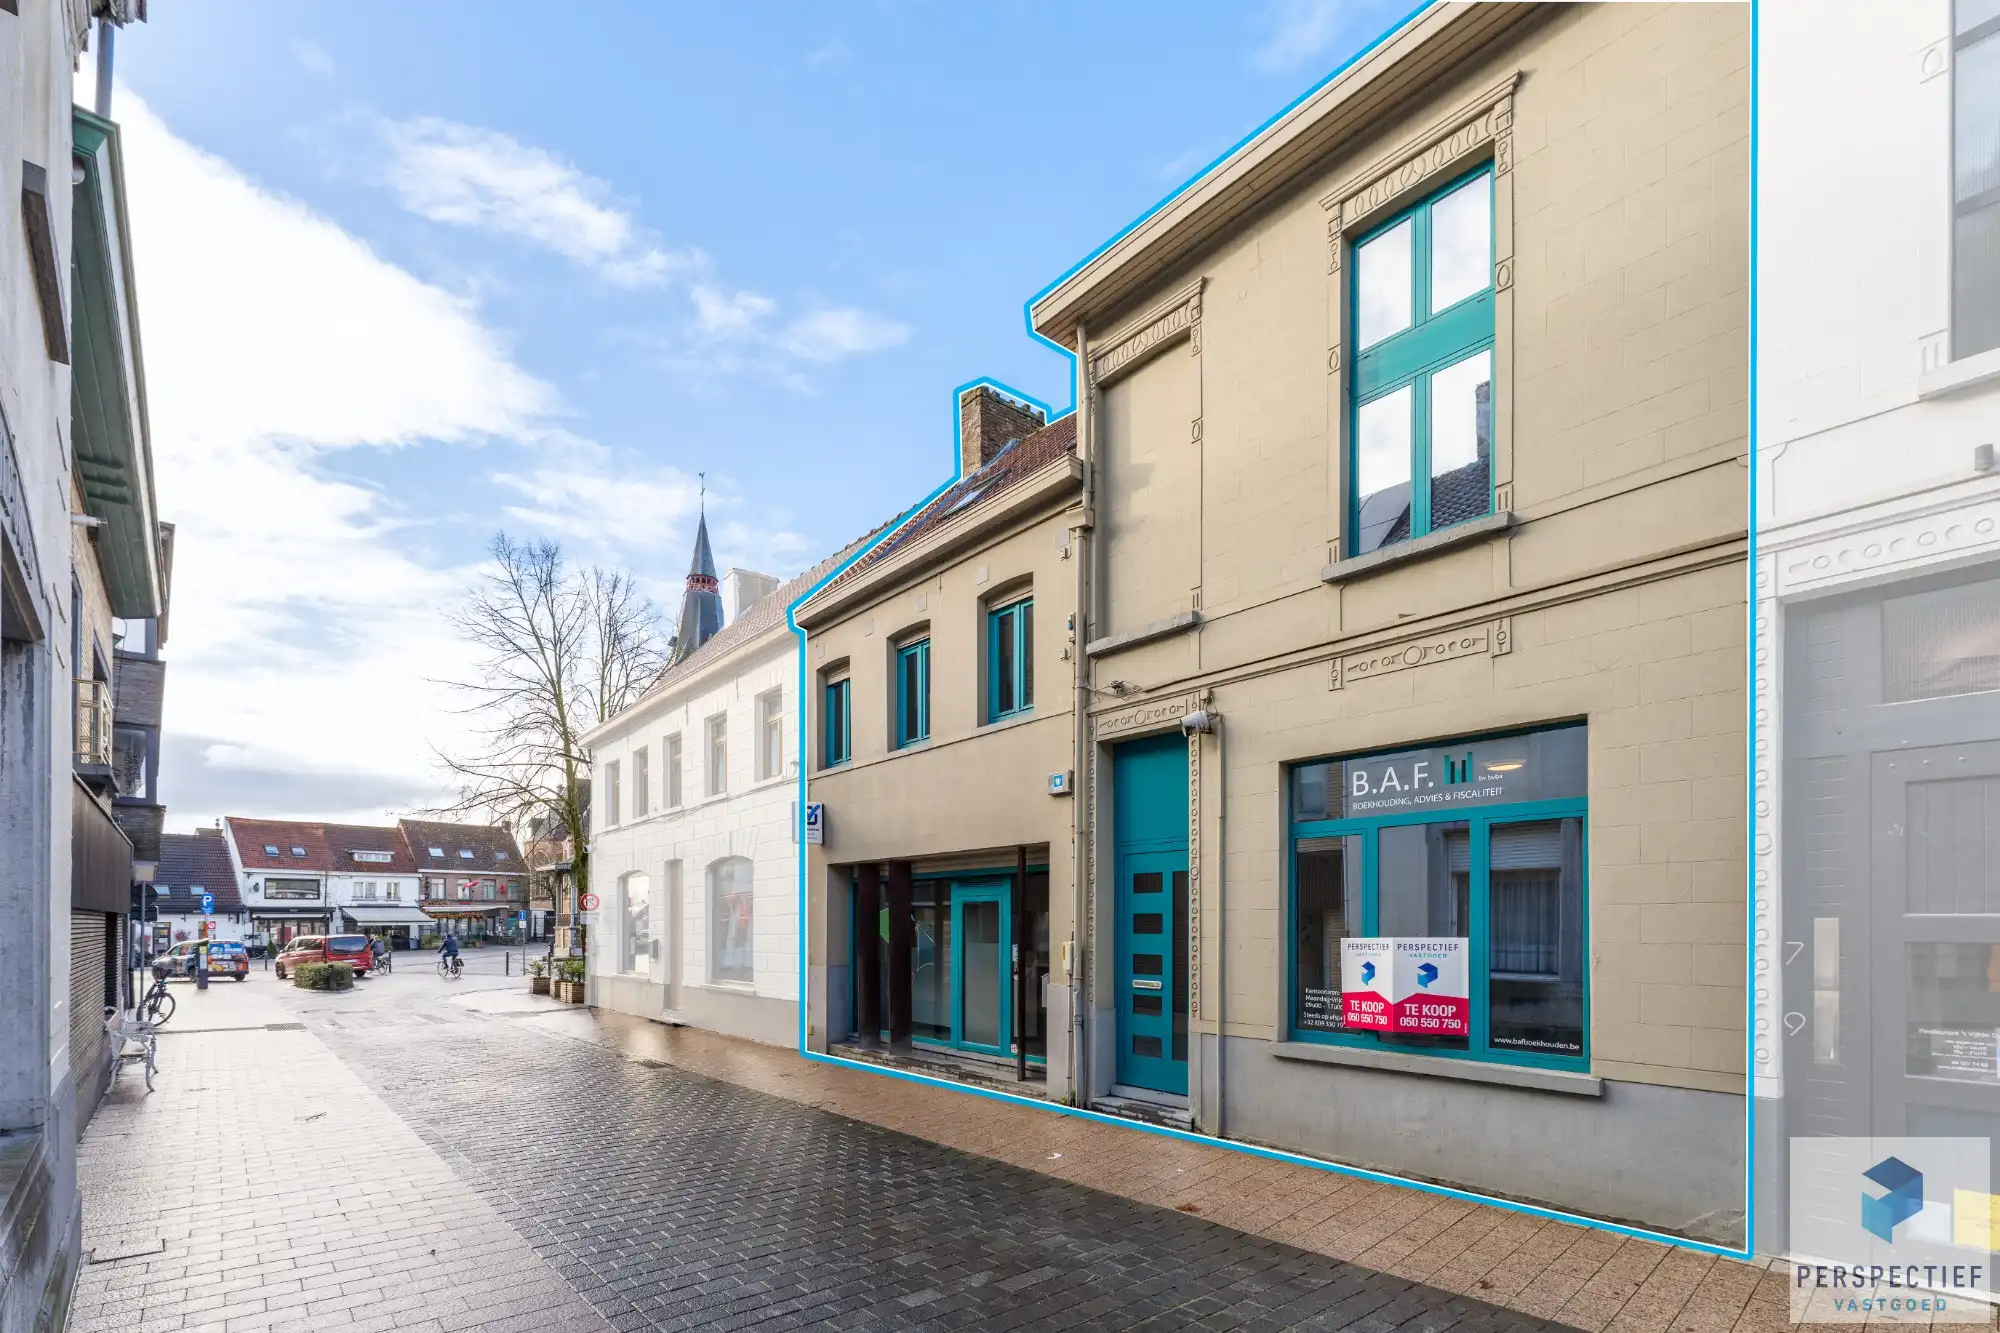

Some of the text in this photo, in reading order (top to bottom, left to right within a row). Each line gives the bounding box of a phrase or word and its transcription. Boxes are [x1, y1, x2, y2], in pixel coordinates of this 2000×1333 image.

[1352, 761, 1434, 796] B.A.F.
[1352, 787, 1502, 810] BOEKHOUDING, ADVIES & FISCALITEIT
[202, 895, 212, 906] P
[1347, 943, 1390, 951] PERSPECTIEF
[1397, 943, 1459, 951] PERSPECTIEF
[1785, 941, 1804, 966] 7
[1350, 1000, 1385, 1013] TE KOOP
[1404, 1004, 1457, 1017] TE KOOP
[1347, 1012, 1360, 1022] 050
[1361, 1013, 1374, 1024] 550
[1374, 1015, 1388, 1026] 750
[1400, 1017, 1418, 1027] 050
[1420, 1018, 1439, 1028] 550
[1441, 1019, 1461, 1029] 750
[1783, 1011, 1806, 1037] 9
[1493, 1037, 1580, 1051] www.bafboekhouden.be
